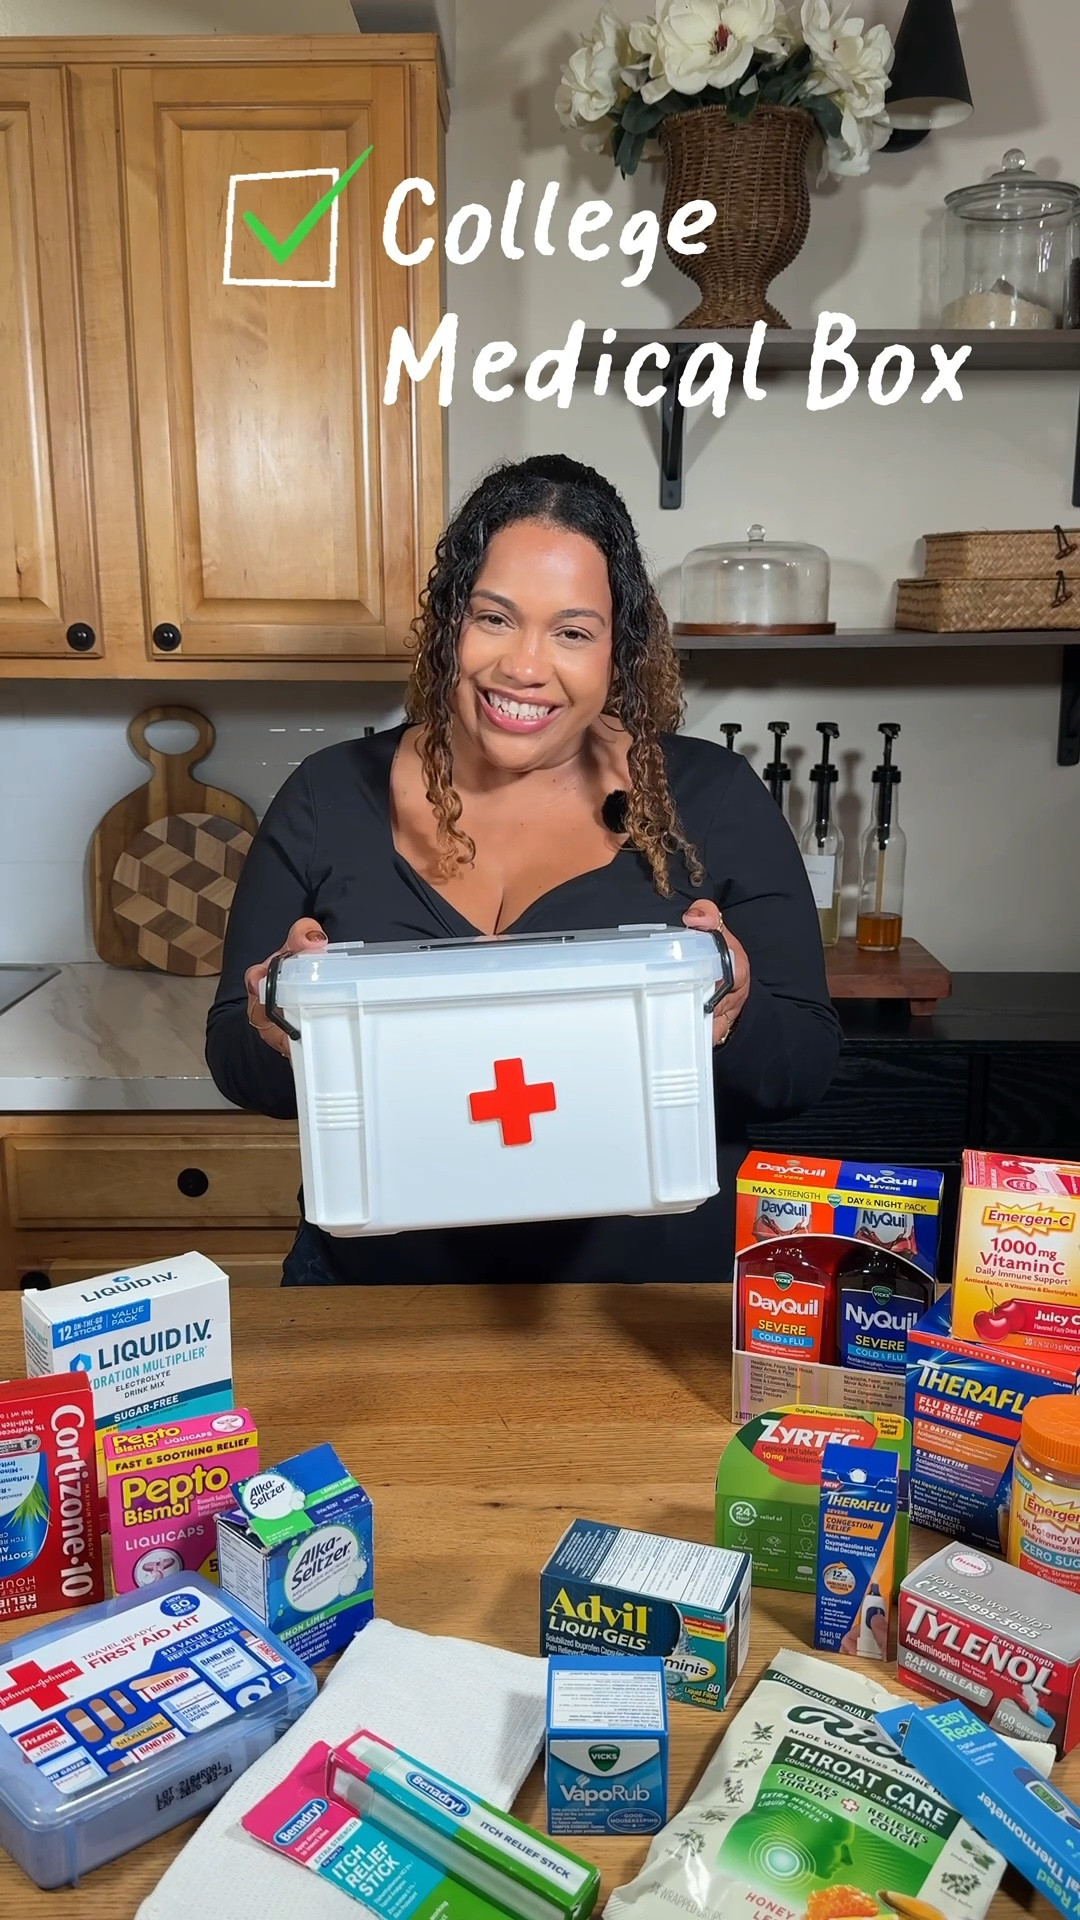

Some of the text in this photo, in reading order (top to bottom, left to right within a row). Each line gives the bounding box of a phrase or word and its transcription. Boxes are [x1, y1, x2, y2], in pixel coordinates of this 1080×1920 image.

[756, 1162, 826, 1178] DayQuil
[855, 1173, 917, 1187] NyQuil
[752, 1186, 776, 1195] MAX
[777, 1188, 821, 1200] STRENGTH
[847, 1196, 864, 1205] DAY
[873, 1198, 903, 1209] NIGHT
[904, 1203, 927, 1212] PACK
[761, 1200, 807, 1217] DayQuil
[862, 1210, 908, 1228] NyQuil
[988, 1209, 1070, 1226] Emergen-C
[990, 1237, 1057, 1261] 1,000 mg
[980, 1252, 1065, 1275] Vitamin C
[81, 1271, 178, 1303] LIQUID I.V.
[975, 1266, 1068, 1285] Daily Immune Support
[111, 1305, 144, 1319] VALUE
[749, 1290, 819, 1316] DayQuil
[73, 1316, 103, 1331] ON-THE-GO
[111, 1314, 138, 1327] PACK
[758, 1319, 806, 1335] SEVERE
[845, 1302, 918, 1331] NyQuil
[1035, 1310, 1069, 1326] Juicy
[58, 1325, 73, 1342] 12
[73, 1324, 103, 1337] STICKS
[758, 1332, 805, 1346] COLD FLU
[99, 1318, 212, 1370] LIQUID I.V.
[855, 1335, 905, 1351] SEVERE
[855, 1348, 903, 1361] COLD FLU
[143, 1349, 205, 1372] MULTIPLIER
[930, 1339, 1051, 1375] MULTI-SYMPTOM FLU RELIEF
[115, 1370, 171, 1392] ELECTROLYTE
[125, 1380, 165, 1399] DRINK MIX
[917, 1359, 1035, 1415] THERAFL
[114, 1394, 179, 1422] SUGAR-FREE
[918, 1405, 977, 1427] MAX STRENGTH
[919, 1395, 984, 1421] FLU RELIEF
[112, 1426, 181, 1448] Pepto
[164, 1431, 213, 1446] LIQUICAPS
[758, 1419, 861, 1448] ZYRTEC
[930, 1425, 962, 1439] DAYTIME
[115, 1440, 157, 1455] Bismol
[115, 1437, 250, 1472] FAST SOOTHING RELIEF
[762, 1451, 784, 1462] 10 mg
[928, 1453, 969, 1470] NIGHTTIME
[122, 1464, 230, 1509] Pepto
[249, 1478, 276, 1501] Alka-
[250, 1482, 286, 1510] Seltzer
[124, 1499, 190, 1527] Bismol
[735, 1506, 751, 1517] 24
[827, 1491, 891, 1514] THERAFLU
[825, 1524, 851, 1533] RELIEF
[826, 1516, 874, 1530] CONGESTION
[125, 1525, 205, 1551] LIQUICAPS
[1031, 1525, 1068, 1545] Potency
[294, 1536, 342, 1573] Alka-
[840, 1547, 876, 1558] Decongestant
[1023, 1540, 1052, 1561] ZERO
[291, 1540, 352, 1591] Seltzer
[9, 1584, 36, 1594] LASTS
[14, 1602, 37, 1613] FAST
[170, 1599, 191, 1612] 80
[546, 1587, 648, 1635] Advil
[925, 1572, 1053, 1632] How can we help?
[927, 1585, 1042, 1639] 1-877-895-3665
[306, 1612, 326, 1627] LIME
[81, 1627, 153, 1661] TRAVEL READY
[87, 1614, 200, 1669] FIRST AID KIT
[167, 1625, 240, 1662] REFILLABLE CASE
[177, 1620, 234, 1649] VALUE WITH
[293, 1625, 319, 1642] STOMACH
[545, 1632, 574, 1647] Solubilized
[905, 1633, 960, 1668] Acetaminophen
[906, 1597, 1052, 1696] TYLENOL
[991, 1634, 1055, 1669] Extra Strength
[663, 1658, 709, 1676] minis
[905, 1661, 922, 1674] GELS
[905, 1651, 938, 1674] RAPID
[938, 1668, 987, 1698] RELEASE
[707, 1683, 720, 1694] 80
[773, 1672, 866, 1718] LIQUID CENTER DUAL
[182, 1704, 201, 1715] HAND
[186, 1700, 220, 1719] CLEANSING
[925, 1709, 968, 1730] Easy
[996, 1710, 1016, 1725] 100
[115, 1719, 164, 1747] NEOSPORIN
[940, 1719, 987, 1743] Read
[591, 1752, 618, 1760] VICKS
[789, 1728, 934, 1790] MADE WITH SWISS ALPINE
[156, 1785, 174, 1801] LOT
[411, 1774, 466, 1814] Benadryl
[559, 1783, 651, 1807] VapoRub
[778, 1769, 838, 1798] SOOTHES
[778, 1777, 832, 1802] THROAT
[784, 1756, 938, 1830] COUGH SUPPRESSANT ORAL ANESTHETIC
[788, 1742, 949, 1827] THROAT CARE
[790, 1796, 833, 1823] MENTHOL
[278, 1803, 323, 1844] Benadryl
[867, 1807, 929, 1844] RELIEVES
[868, 1817, 919, 1849] COUGH
[977, 1791, 1064, 1883] Thermometer
[480, 1820, 572, 1880] ITCH RELIEF STICK
[331, 1844, 367, 1880] ITCH
[344, 1840, 389, 1889] RELIEF
[358, 1854, 400, 1898] STICK
[1036, 1868, 1071, 1907] Read
[745, 1891, 797, 1920] HONEY
